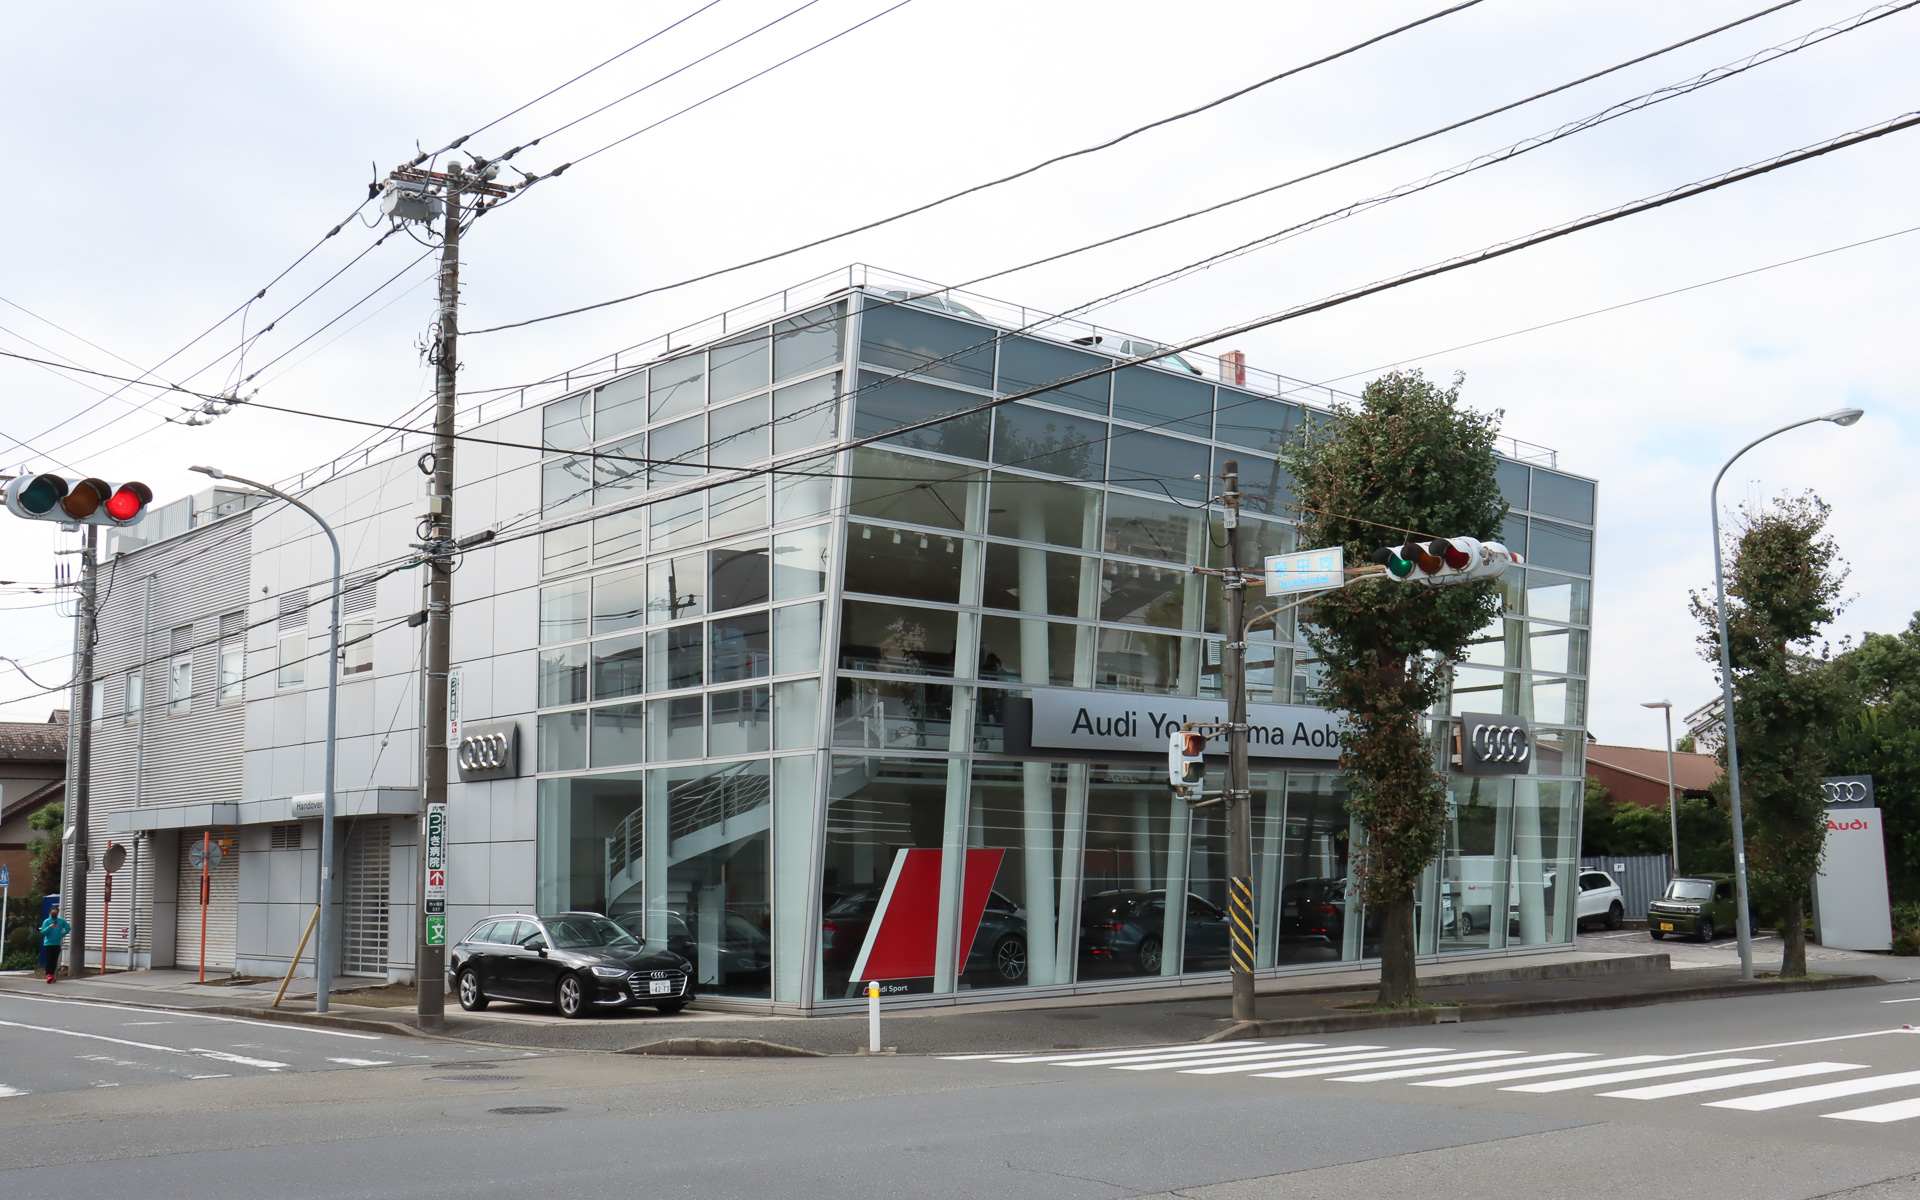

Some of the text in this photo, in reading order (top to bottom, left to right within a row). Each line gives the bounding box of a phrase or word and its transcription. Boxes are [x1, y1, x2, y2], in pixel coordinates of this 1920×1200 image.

[1274, 555, 1333, 578] 泉田向
[1071, 707, 1137, 738] Audi
[1292, 721, 1339, 748] Aob
[297, 801, 323, 811] Handover
[1825, 819, 1868, 831] Audi
[430, 814, 442, 868] つづき病院
[431, 923, 444, 940] 文
[888, 984, 908, 993] Sport
